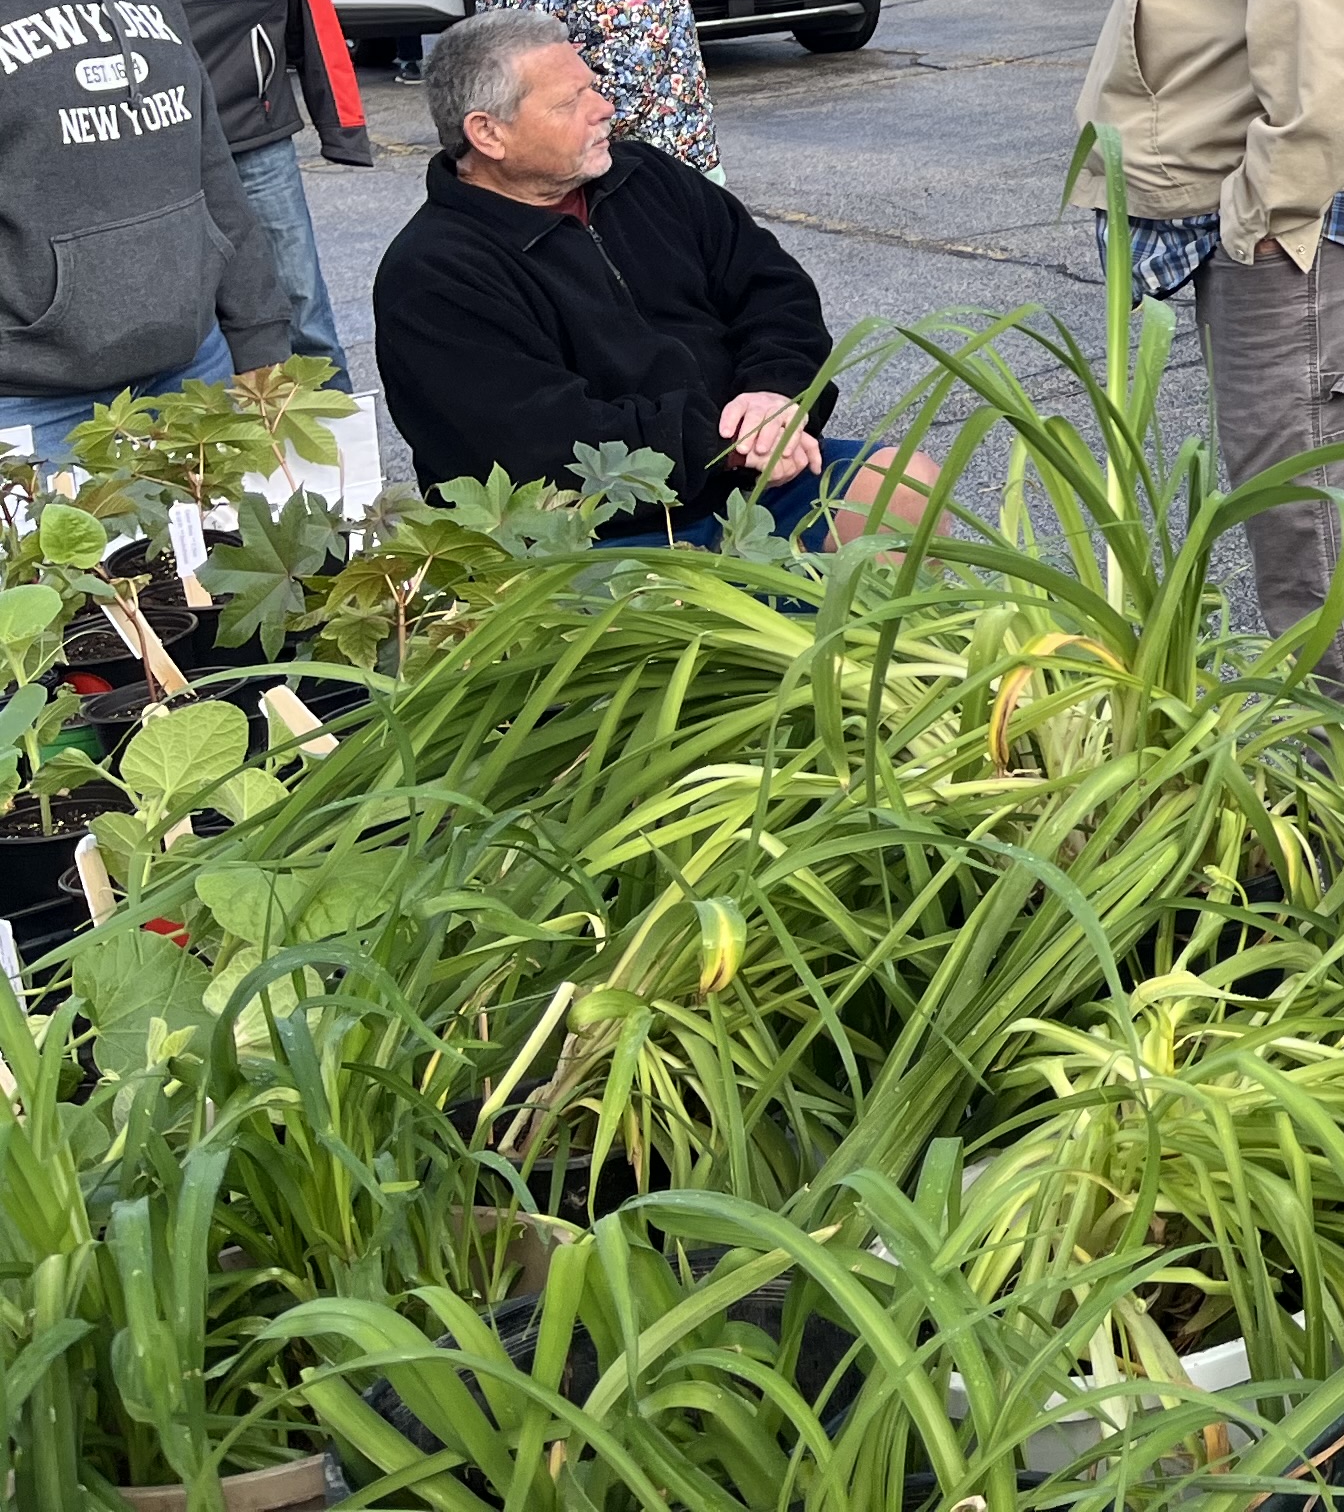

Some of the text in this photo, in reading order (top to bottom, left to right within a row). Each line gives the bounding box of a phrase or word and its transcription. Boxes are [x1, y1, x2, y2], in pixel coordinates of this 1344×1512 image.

[0, 4, 88, 75] NEW
[83, 57, 142, 85] EST. 164
[58, 85, 193, 144] NEW YORK
